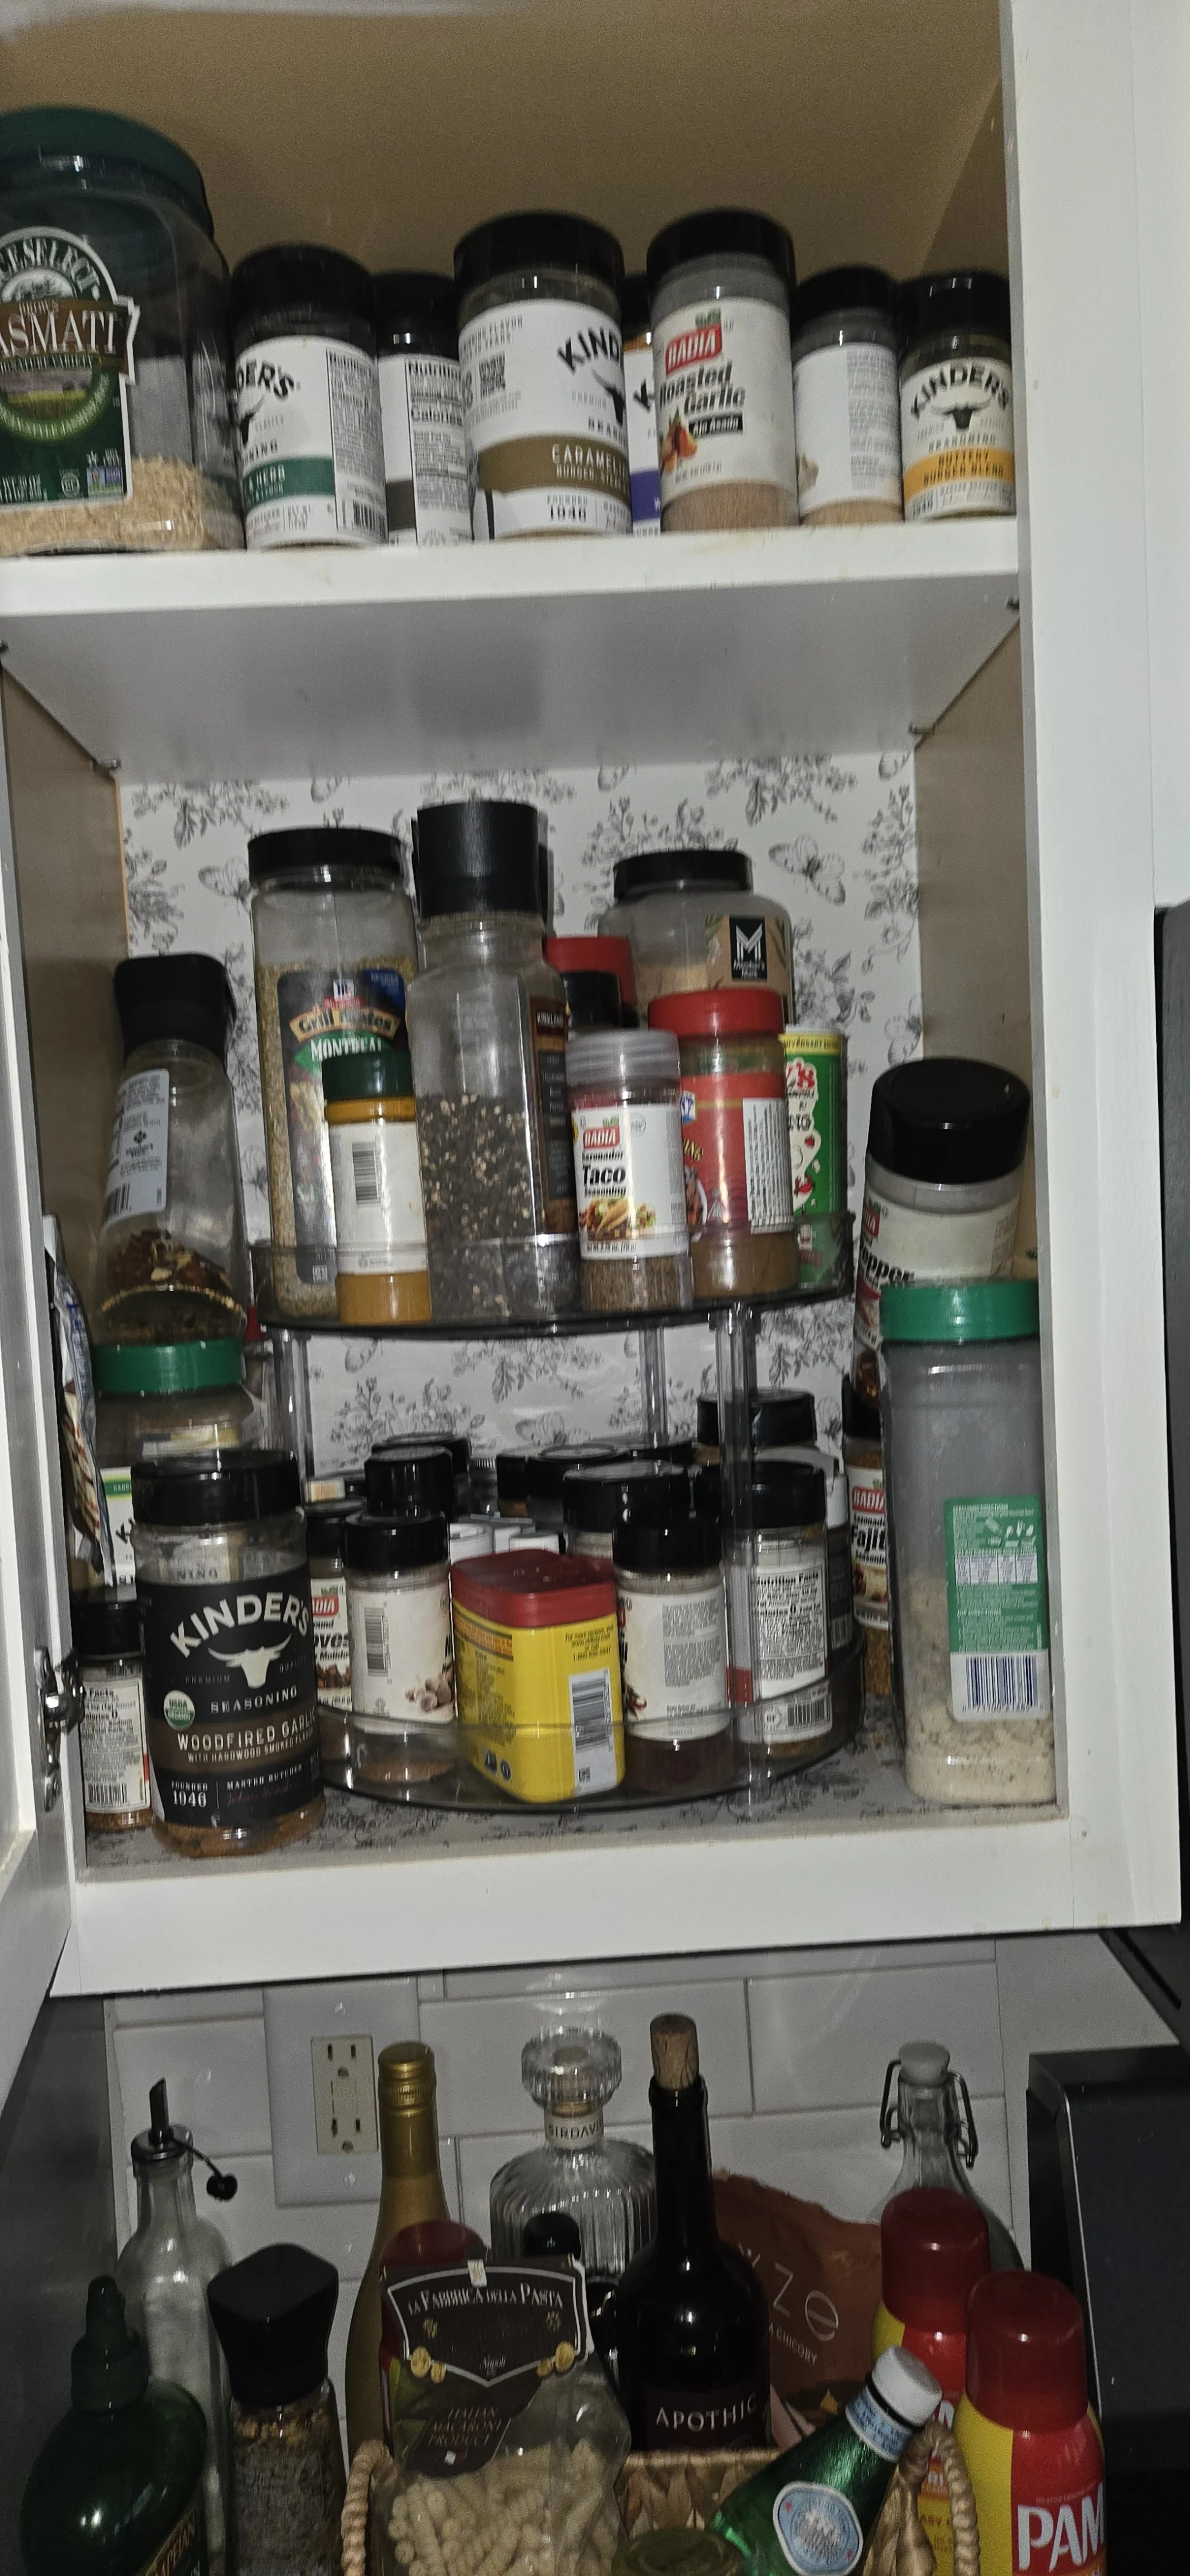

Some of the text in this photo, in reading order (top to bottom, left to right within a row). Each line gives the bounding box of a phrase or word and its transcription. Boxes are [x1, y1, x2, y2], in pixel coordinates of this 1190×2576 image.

[668, 329, 715, 370] BADIA
[585, 1129, 616, 1147] BADIA
[582, 1164, 626, 1186] Taco
[170, 1591, 309, 1658] KINDER'S
[169, 1698, 188, 1709] USDA
[211, 1685, 298, 1714] SEASONING
[178, 1706, 316, 1751] WOODFIRED GARLIC
[188, 1752, 208, 1763] WITH
[212, 1750, 261, 1763] HARDWOOD
[265, 1737, 293, 1756] SMOKED
[171, 1780, 208, 1792] FOUNDED
[173, 1790, 207, 1808] 1946
[421, 2287, 484, 2311] FABBRICA
[520, 2283, 564, 2309] PASTA
[655, 2392, 757, 2432] APOTHIC
[1017, 2482, 1105, 2572] PAM
